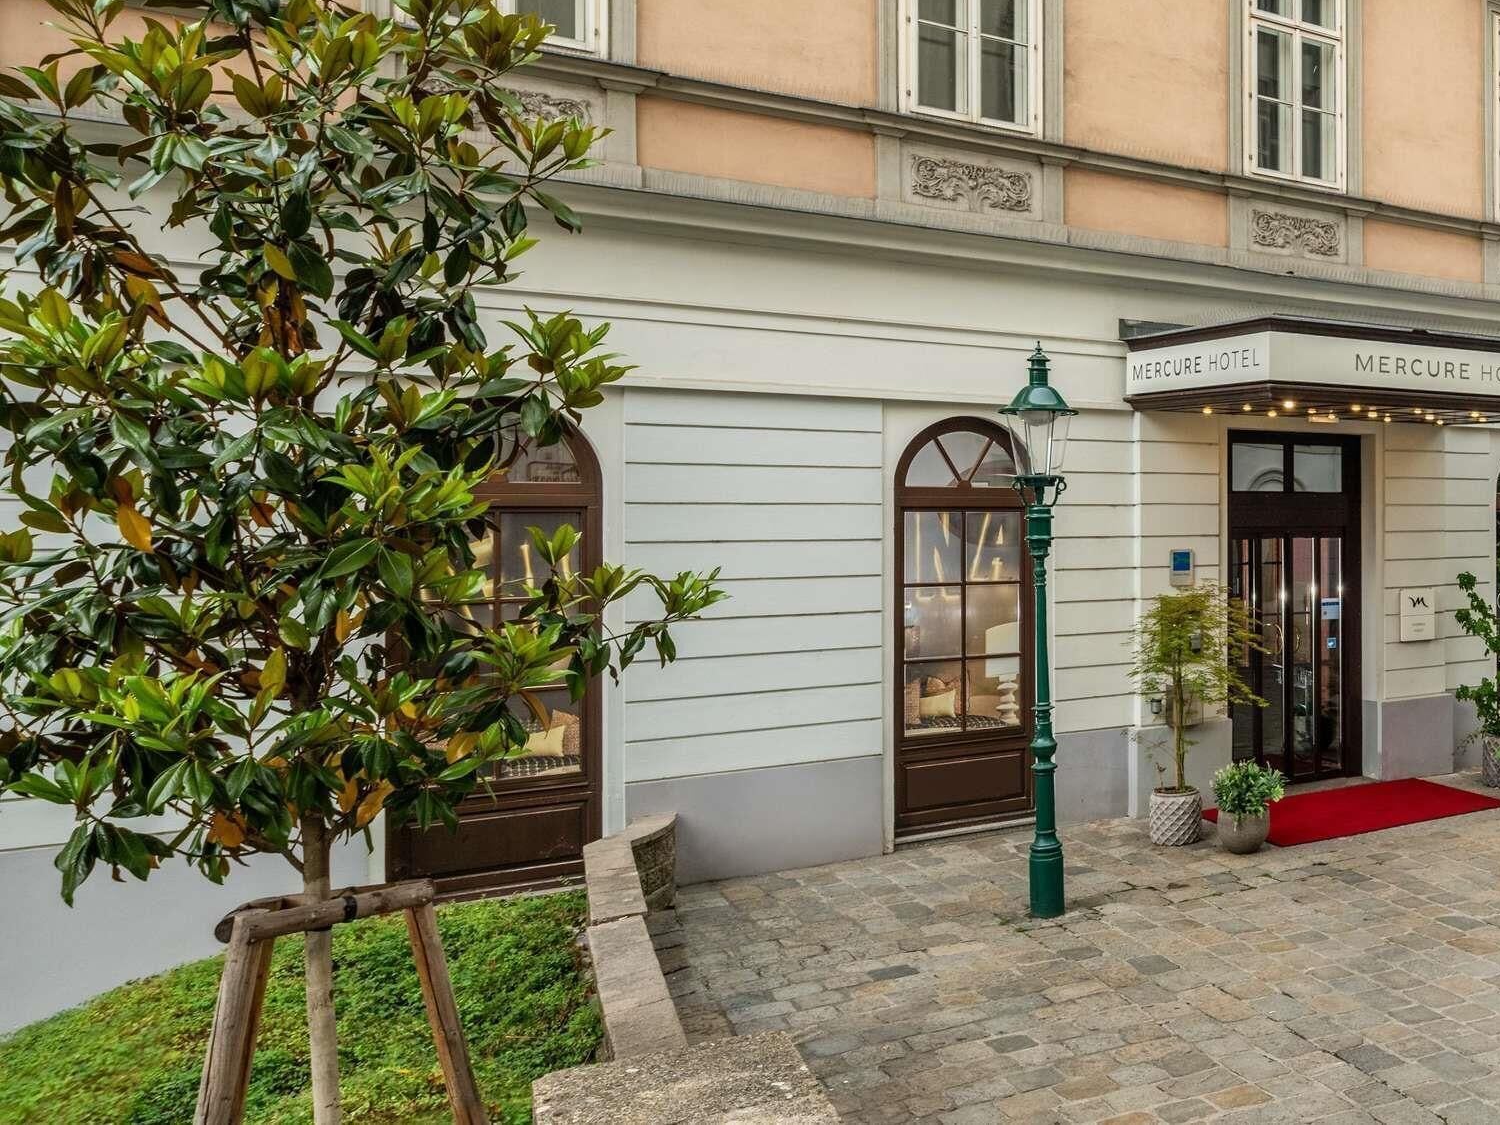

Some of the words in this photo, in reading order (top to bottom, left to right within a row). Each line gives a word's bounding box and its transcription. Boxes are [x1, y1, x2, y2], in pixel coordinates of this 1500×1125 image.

[1132, 356, 1202, 381] MERCURE
[1208, 348, 1260, 371] HOTEL
[1355, 354, 1470, 380] MERCURE
